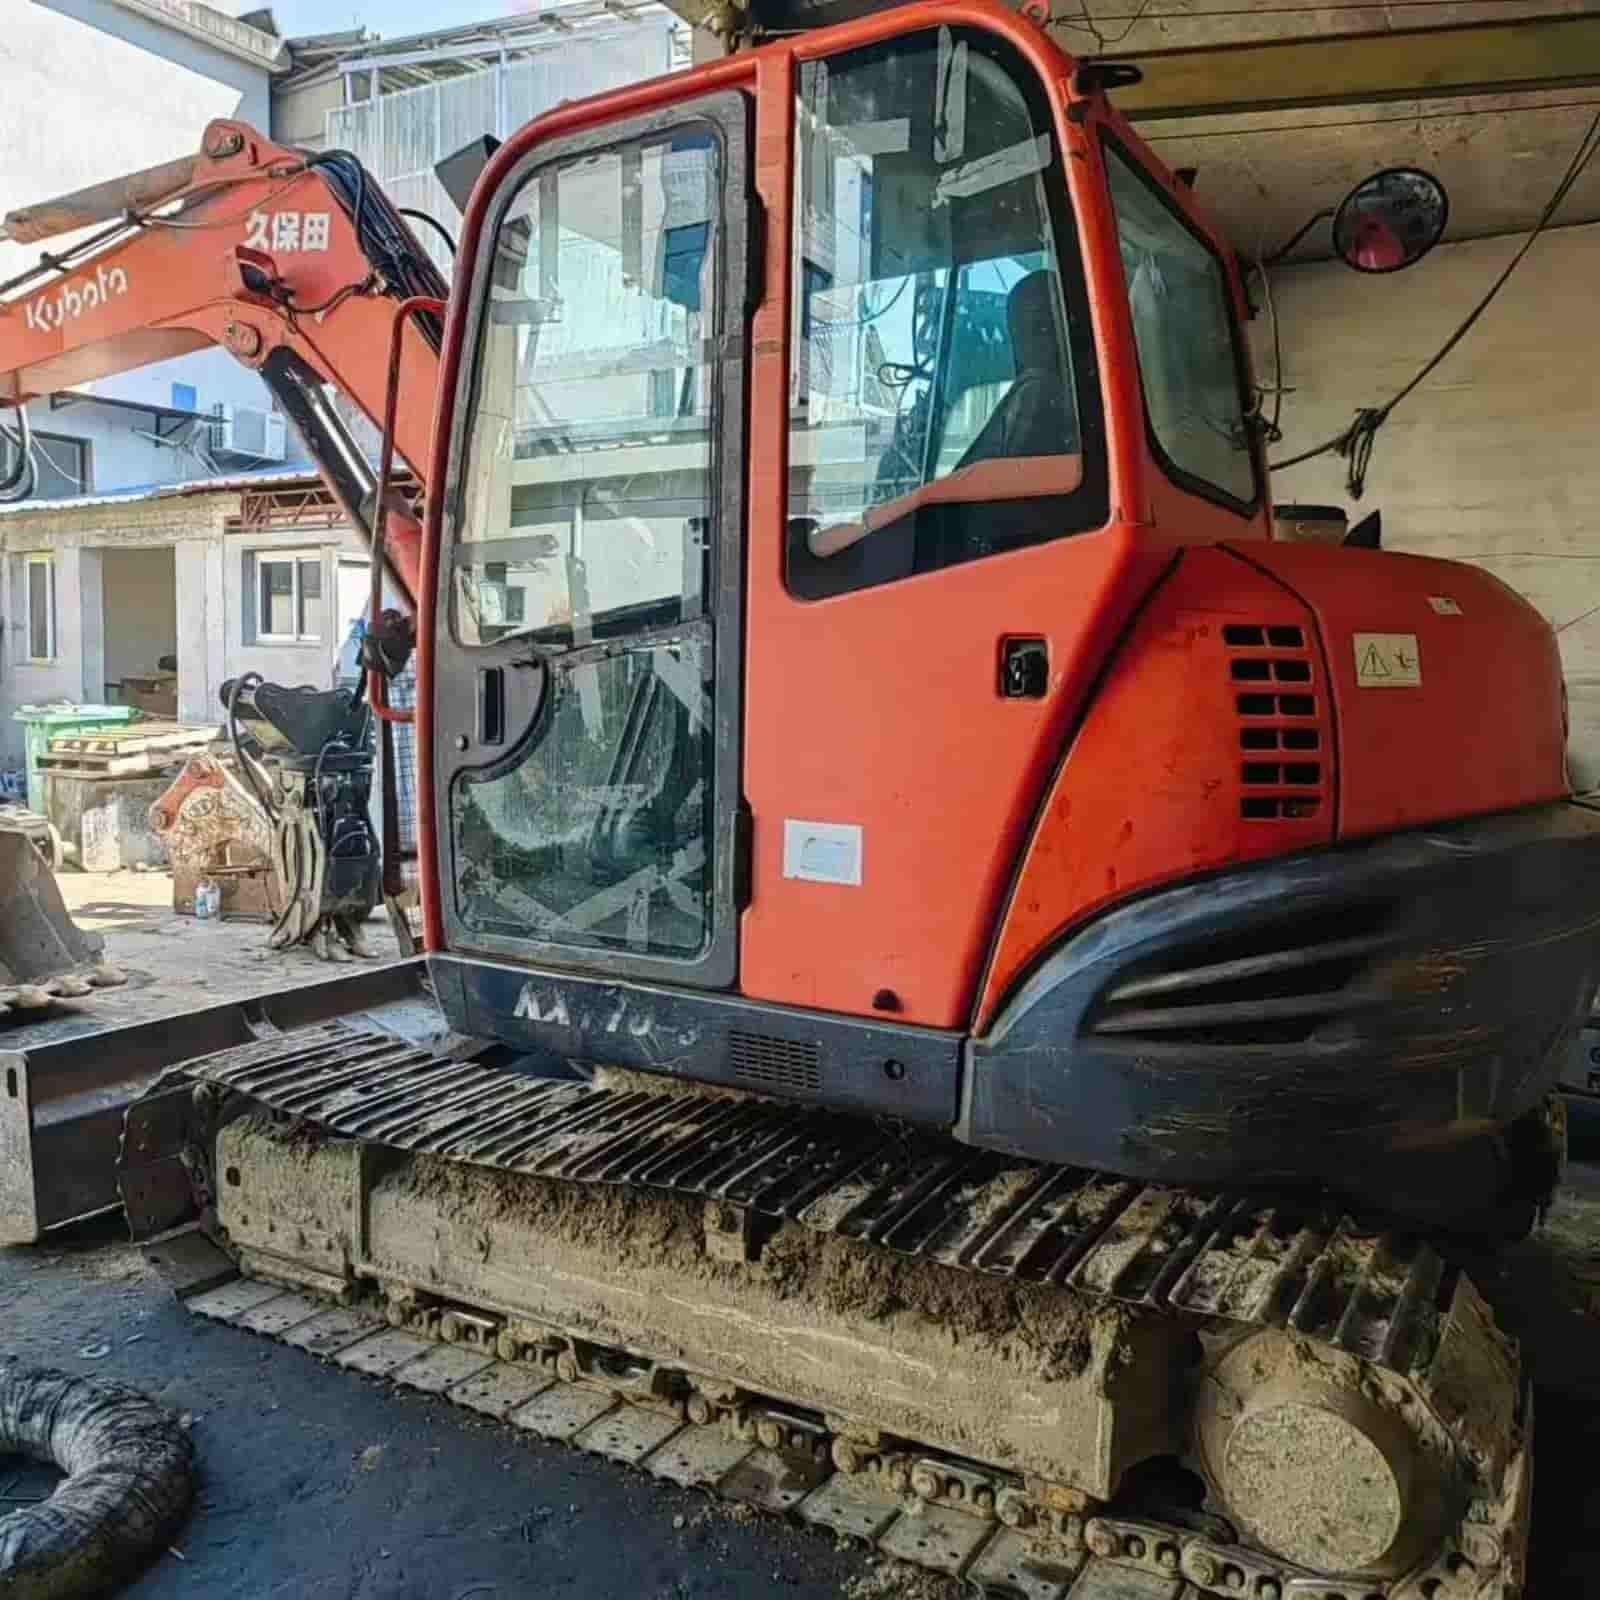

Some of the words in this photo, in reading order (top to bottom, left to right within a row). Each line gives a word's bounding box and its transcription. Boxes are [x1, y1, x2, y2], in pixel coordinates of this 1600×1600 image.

[244, 209, 329, 252] 久保田
[26, 264, 128, 332] Kubota
